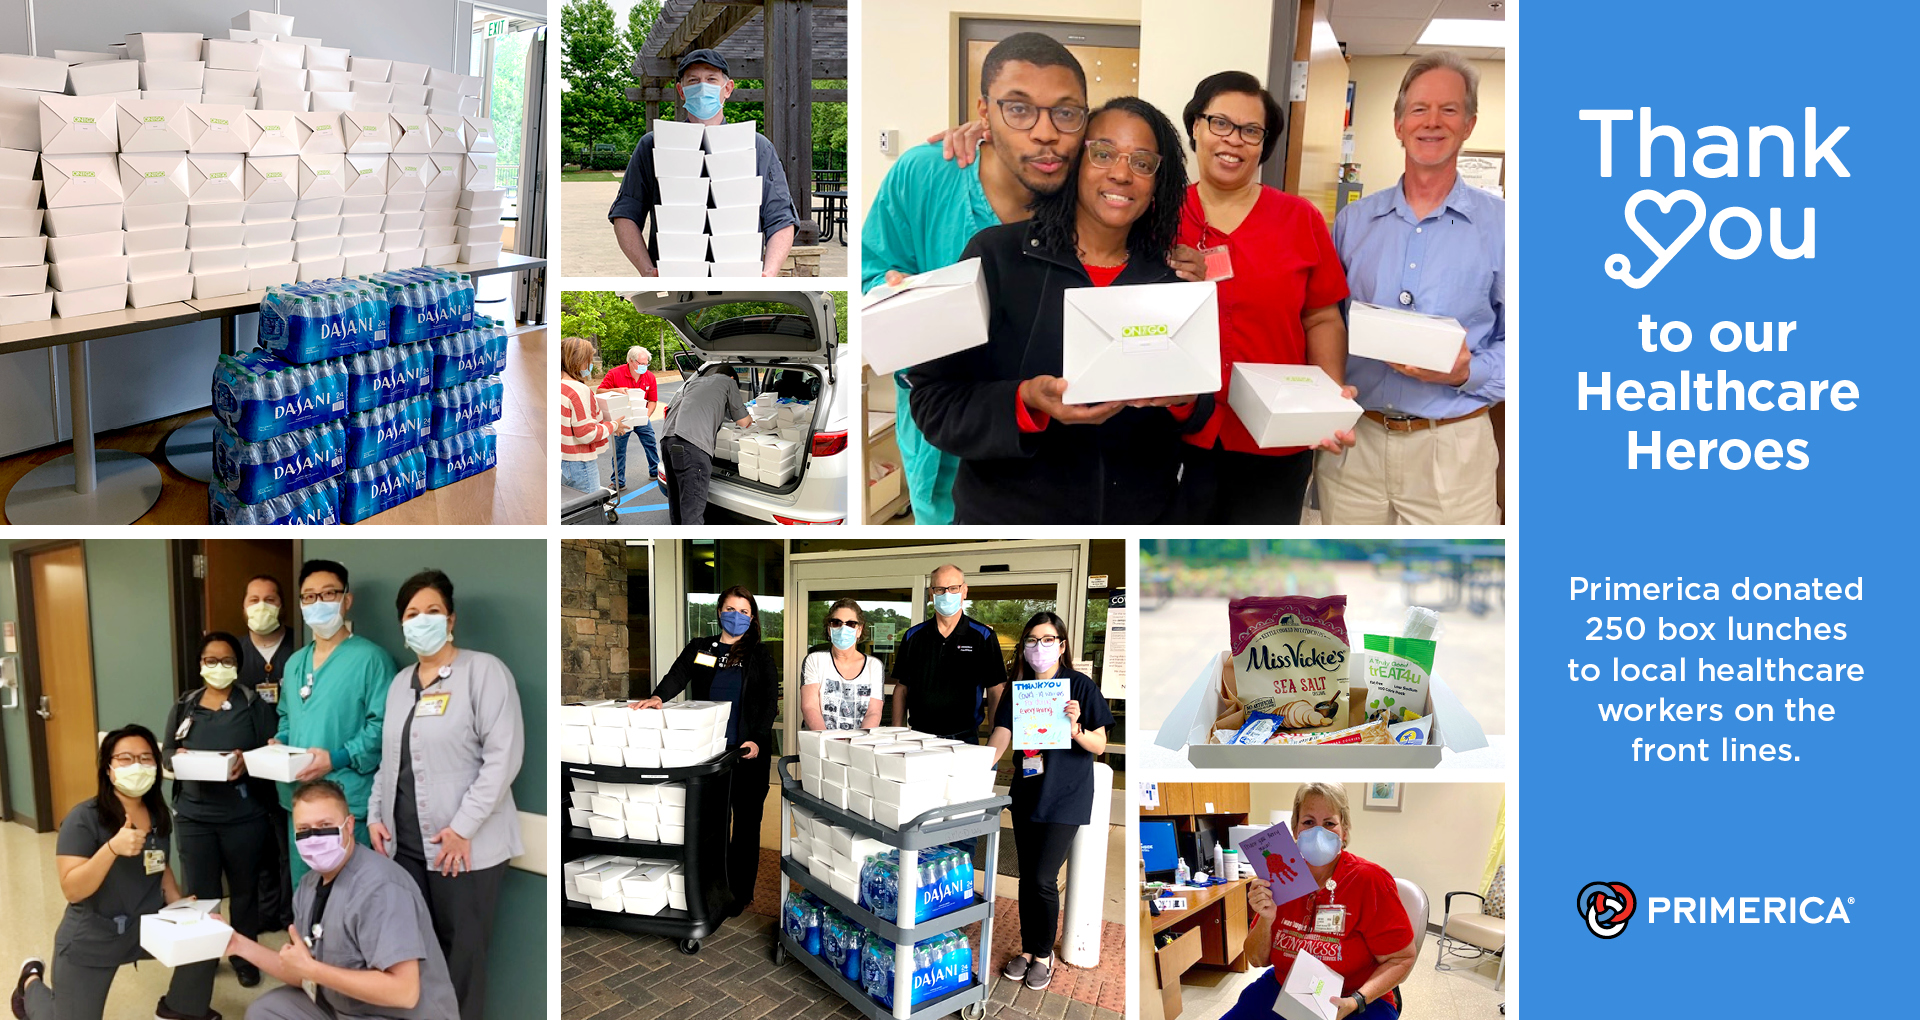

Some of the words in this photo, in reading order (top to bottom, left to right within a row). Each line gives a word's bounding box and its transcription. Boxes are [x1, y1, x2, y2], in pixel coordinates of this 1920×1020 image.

[488, 20, 505, 36] EXIT
[417, 304, 461, 324] DASANI
[321, 317, 373, 340] DASANI
[458, 351, 497, 371] DASANI
[373, 368, 419, 391] DASANI
[274, 392, 330, 419] DASANI
[455, 400, 492, 422] DASANI
[377, 417, 420, 444] DASANI
[274, 450, 329, 480] DASANI
[447, 450, 486, 473] DASANI
[371, 471, 415, 499] DASANI
[1246, 645, 1292, 672] Miss
[1282, 640, 1346, 672] Vickie's
[1014, 682, 1043, 690] THANK
[1273, 679, 1297, 694] SEA
[1300, 676, 1326, 692] SALT
[1369, 665, 1421, 685] trEAT4u
[924, 879, 963, 905] DASANI
[1276, 933, 1339, 957] KINDNESS
[914, 964, 957, 989] DASANI
